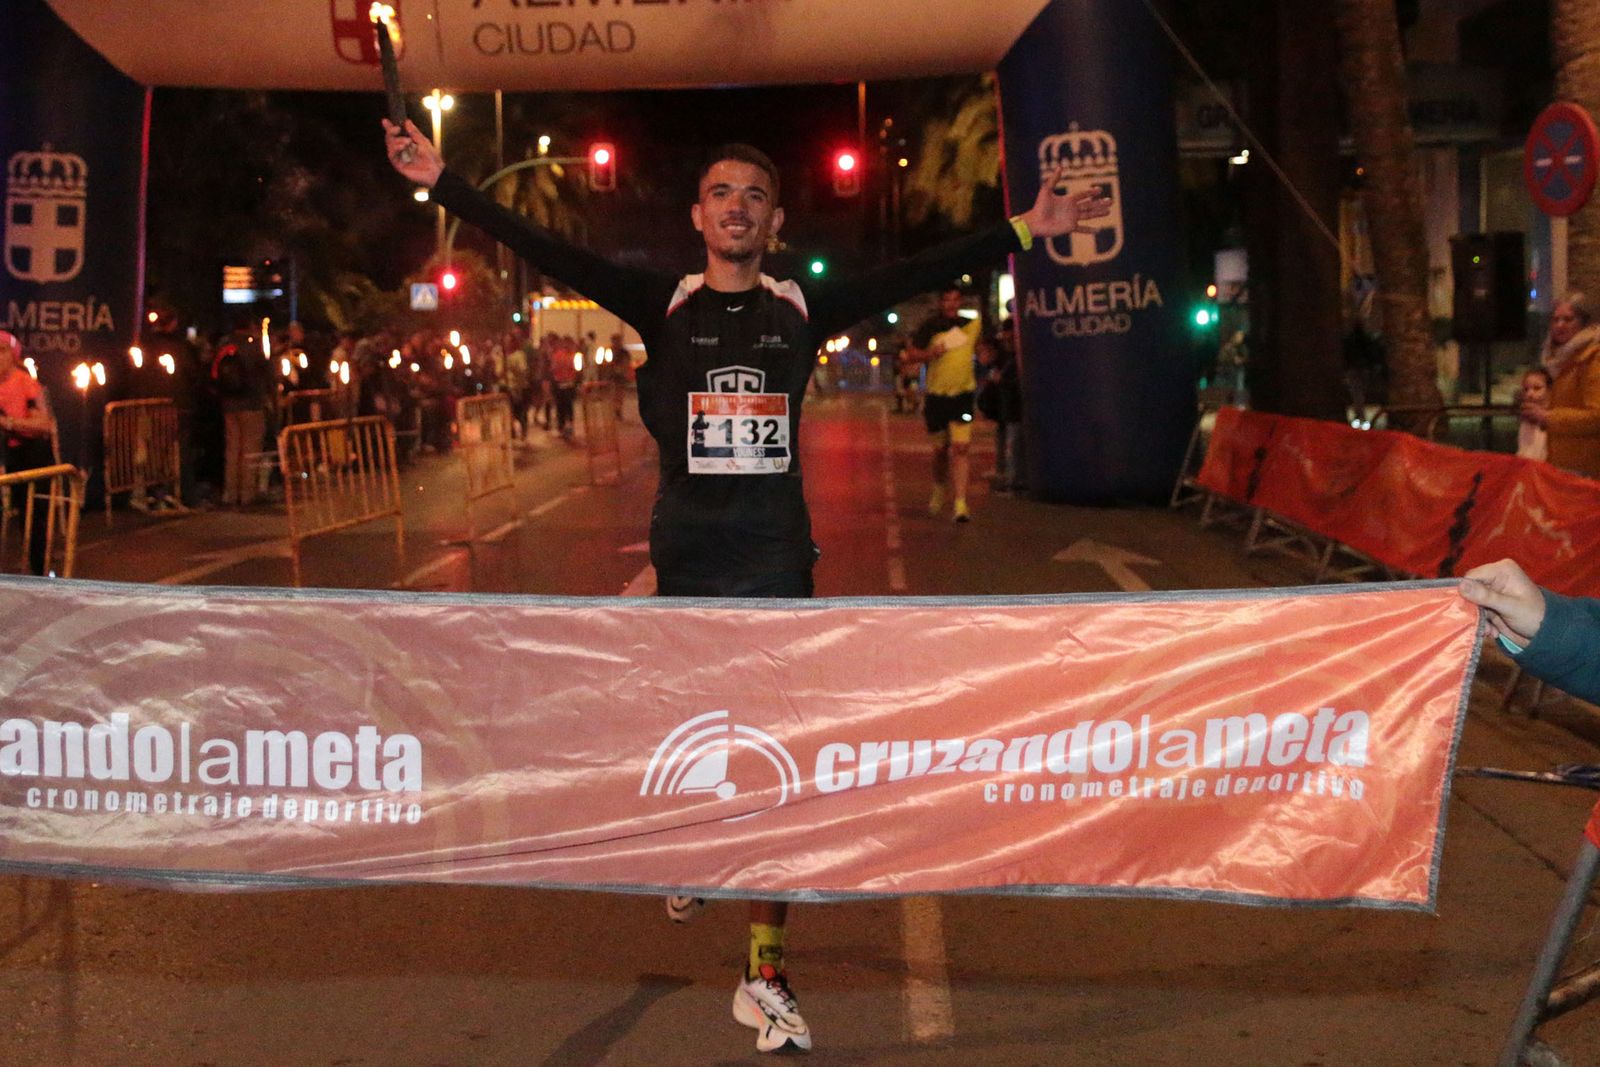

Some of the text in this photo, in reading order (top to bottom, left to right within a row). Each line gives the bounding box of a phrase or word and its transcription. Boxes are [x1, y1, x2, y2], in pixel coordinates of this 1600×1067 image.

[472, 21, 636, 56] CIUDAD
[1024, 273, 1164, 317] ALMERÍA
[1052, 314, 1132, 337] CIUDAD
[718, 418, 779, 445] 132
[984, 769, 1365, 803] cronometraje deportivo
[26, 786, 422, 825] cronometraje deportivo
